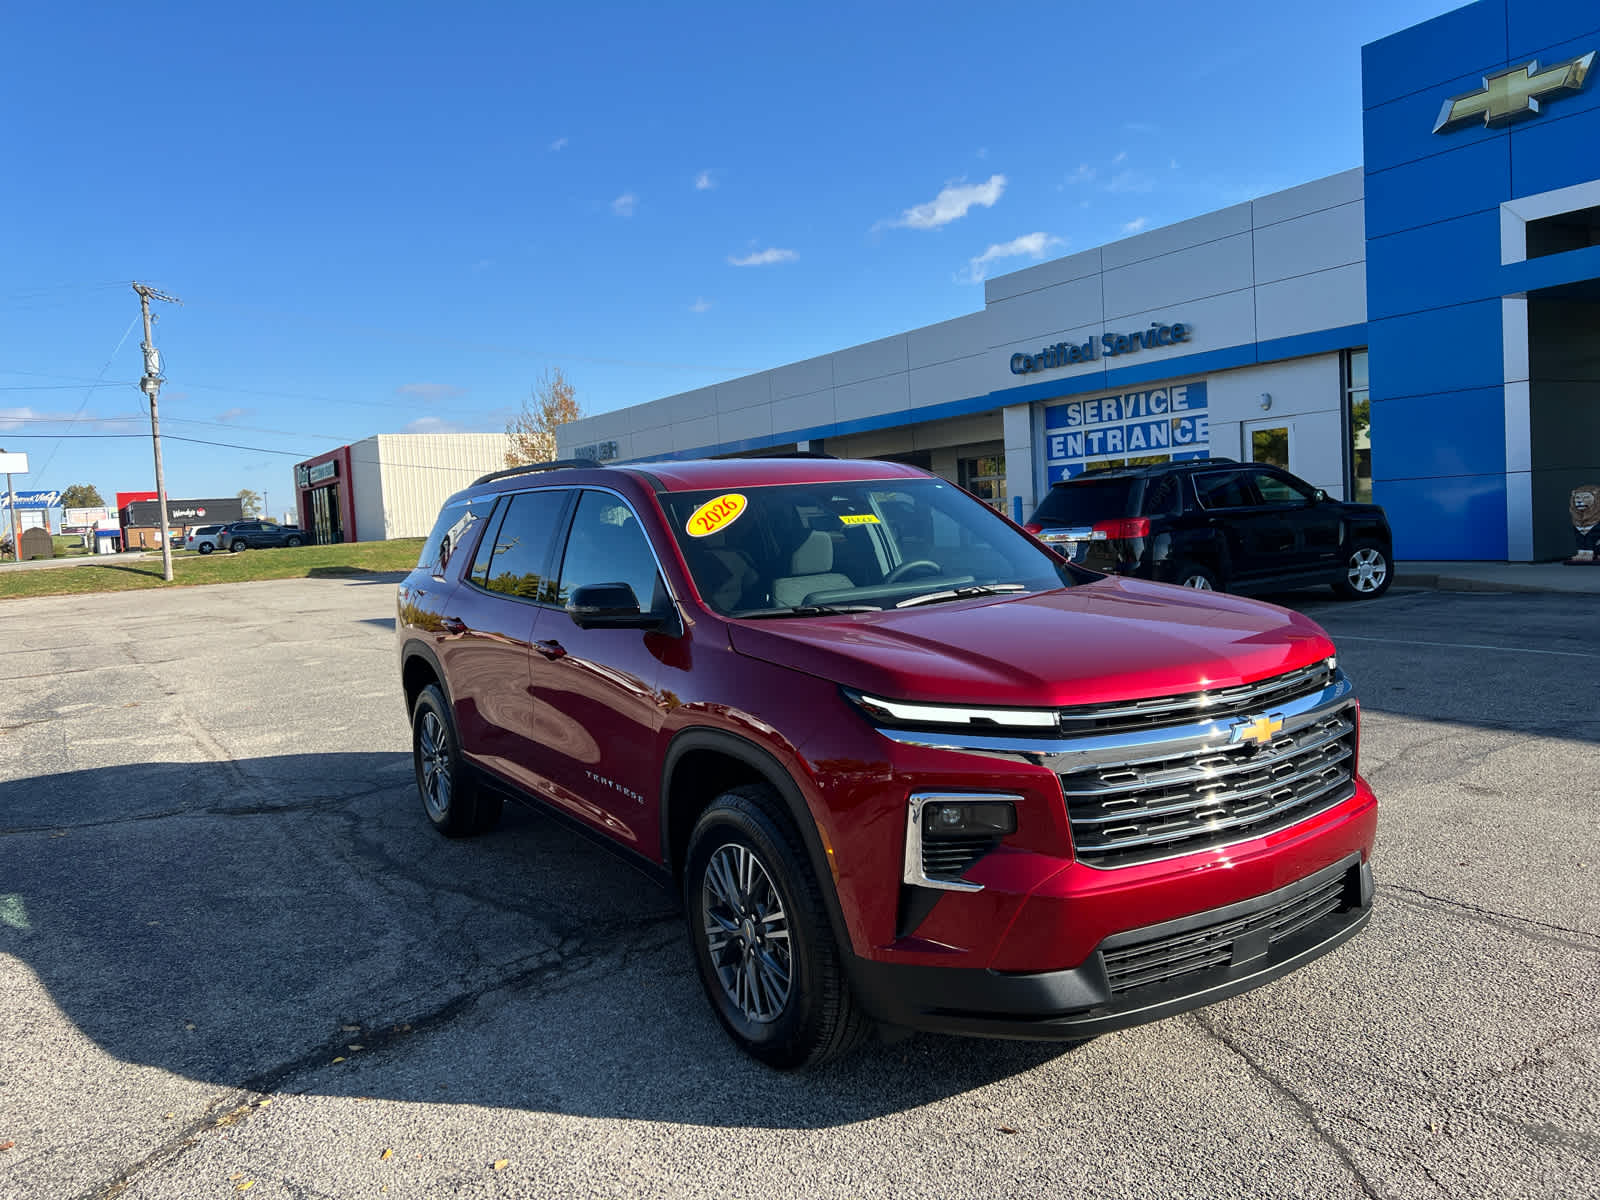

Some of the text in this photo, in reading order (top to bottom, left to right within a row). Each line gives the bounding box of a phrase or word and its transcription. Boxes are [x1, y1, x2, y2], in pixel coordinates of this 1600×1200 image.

[1010, 322, 1190, 375] Certified Service
[1067, 386, 1189, 426] SERVICE
[1052, 417, 1209, 458] ENTRANCE
[696, 496, 738, 531] 2026
[585, 769, 645, 805] TRAVERSE
